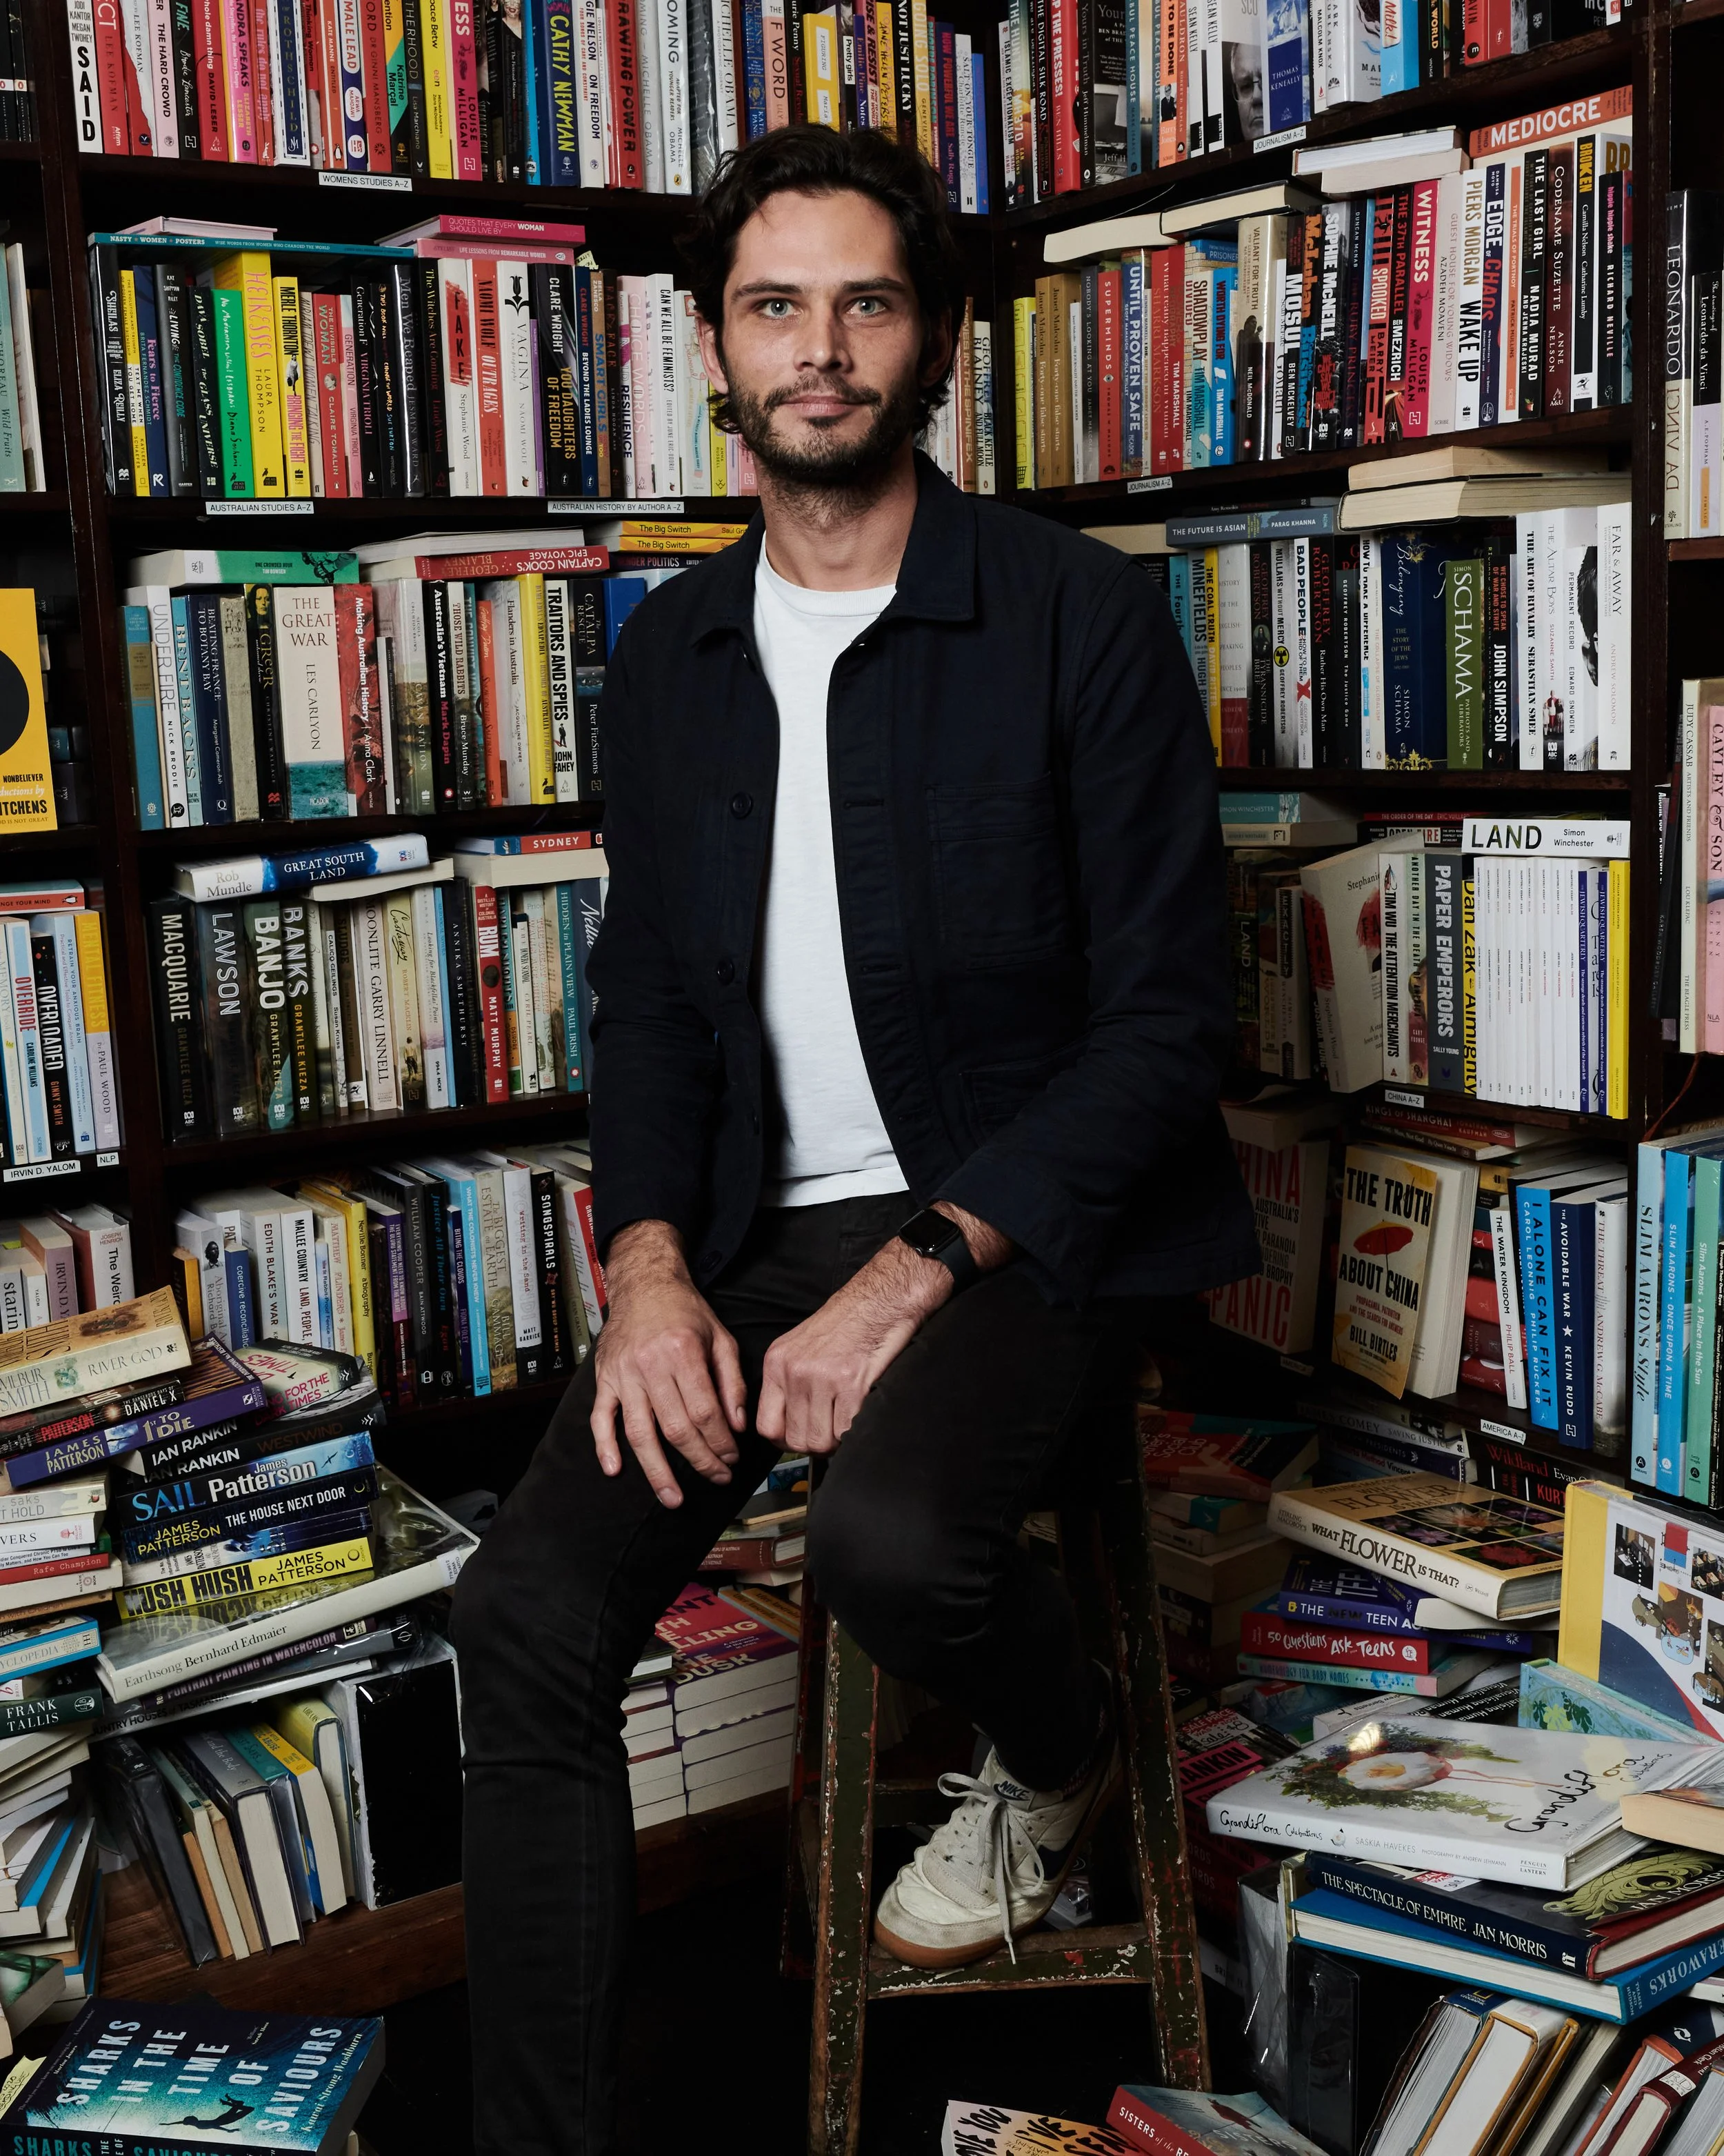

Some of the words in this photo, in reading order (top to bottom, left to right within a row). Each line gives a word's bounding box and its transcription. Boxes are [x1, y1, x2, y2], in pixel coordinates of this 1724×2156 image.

[70, 11, 91, 21] KANTOR
[72, 23, 90, 32] MEGAN
[71, 33, 92, 43] TWOHEY
[550, 15, 571, 75] CATHY
[159, 46, 168, 75] HARD
[161, 77, 170, 117] CROWD
[589, 75, 597, 87] ON
[210, 103, 218, 132] LESER
[553, 81, 575, 152] NEWMAN
[590, 90, 601, 139] FREEDOM
[1491, 97, 1601, 148] MEDIOCRE
[1255, 134, 1291, 150] JOURNALISM
[323, 175, 359, 185] WOMENS
[360, 177, 392, 187] STUDIES
[1579, 143, 1592, 193] BROKEN
[1465, 181, 1483, 221] PIERS
[1414, 189, 1432, 283] WITNESS
[1463, 226, 1481, 286] MORGAN
[319, 305, 330, 364] WOMAN
[1458, 299, 1481, 354] WAKE
[1129, 336, 1141, 389] PROVEN
[1458, 359, 1479, 382] UP
[255, 369, 265, 432] THOMPSON
[264, 369, 272, 406] LAURA
[1172, 379, 1181, 428] MARSHALL
[328, 396, 337, 432] CLAIRE
[1130, 392, 1141, 430] SAFE
[330, 435, 339, 475] TOMALIN
[639, 525, 651, 533] The
[653, 525, 665, 535] Big
[667, 525, 691, 534] Switch
[1187, 526, 1214, 535] FUTURE
[1224, 523, 1245, 532] ASIAN
[151, 604, 172, 669] UNDER
[283, 614, 333, 628] GREAT
[291, 634, 329, 646] WAR
[1494, 644, 1506, 678] JOHN
[158, 674, 177, 711] FIRE
[1494, 681, 1507, 742] SIMPSON
[554, 752, 572, 761] JOHN
[554, 762, 574, 772] FAHEY
[3, 773, 43, 783] NONBELIEVER
[534, 837, 579, 848] SYDNEY
[1472, 825, 1542, 848] LAND
[1554, 839, 1594, 847] Winchester
[217, 871, 239, 883] Rob
[284, 857, 323, 872] GREAT
[324, 852, 365, 866] SOUTH
[310, 866, 345, 881] LAND
[206, 883, 252, 897] Mundle
[480, 926, 499, 958] RUM
[161, 914, 191, 1023] MACQUARIE
[212, 913, 241, 1016] LAWSON
[254, 917, 285, 1010] BANJO
[15, 977, 37, 1032] OVERRIDE
[371, 976, 382, 1015] GARRY
[488, 996, 497, 1024] MATT
[37, 986, 64, 1071] OVERLOADED
[375, 1019, 389, 1084] LINNELL
[490, 1028, 501, 1068] MURPHY
[1388, 1092, 1406, 1102] CHINA
[11, 1168, 32, 1178] IRVIN
[47, 1163, 76, 1174] YALOM
[100, 1155, 116, 1164] NLP
[1347, 1168, 1379, 1208] THE
[1385, 1178, 1433, 1227] TRUTH
[1339, 1255, 1383, 1297] ABOUT
[1385, 1270, 1419, 1310] CHINA
[88, 1356, 128, 1377] RIVER
[131, 1345, 162, 1364] GOD
[1564, 1346, 1572, 1380] KEVIN
[125, 1398, 166, 1416] DANIEL
[168, 1390, 177, 1401] X
[152, 1450, 179, 1466] IAN
[181, 1420, 238, 1451] RANKIN
[1483, 1423, 1512, 1437] AMERICA
[131, 1481, 206, 1522] SAIL
[1312, 1524, 1340, 1541] WHAT
[1341, 1530, 1417, 1578] FLOWER
[1418, 1564, 1426, 1574] IS
[1428, 1567, 1459, 1588] THAT?
[124, 1573, 188, 1616] HUSH
[193, 1565, 254, 1604] HUSH
[1301, 1603, 1323, 1617] THE
[185, 1641, 239, 1668] Bernhard
[241, 1624, 288, 1648] Edmaier
[1267, 1632, 1281, 1642] 50
[1283, 1634, 1327, 1650] Questions
[1331, 1639, 1352, 1656] Ask
[1356, 1640, 1396, 1658] Teens
[674, 1653, 759, 1685] DUSK
[6, 1699, 57, 1719] FRANK
[8, 1713, 59, 1733] TALLIS
[1000, 1780, 1029, 1799] NIKE
[1356, 1837, 1381, 1849] SASKIA
[1383, 1841, 1416, 1853] HAVEKES
[1322, 1871, 1343, 1890] THE
[1345, 1881, 1405, 1910] SPECTACLE
[1406, 1902, 1420, 1916] OF
[1423, 1906, 1467, 1933] EMPIRE
[1472, 1923, 1496, 1942] JAN
[1499, 1931, 1547, 1959] MORRIS
[57, 2019, 141, 2105] SHARKS
[109, 2079, 154, 2105] IN
[134, 2028, 187, 2068] THE
[167, 2043, 230, 2095] TIME
[228, 2060, 270, 2086] OF
[256, 2027, 343, 2133] SAVIOURS
[1119, 2106, 1156, 2139] SISTERS
